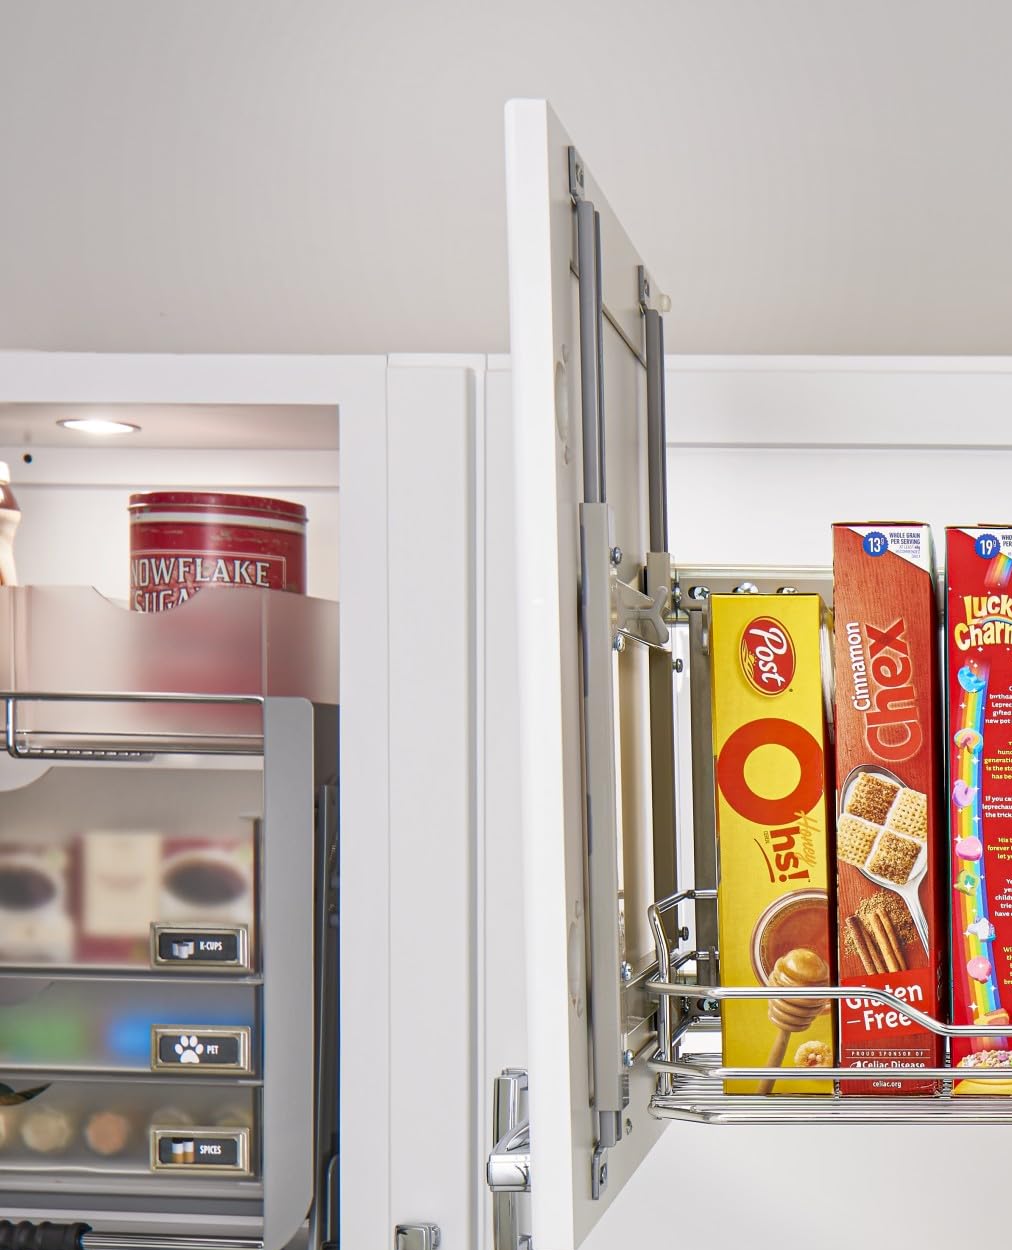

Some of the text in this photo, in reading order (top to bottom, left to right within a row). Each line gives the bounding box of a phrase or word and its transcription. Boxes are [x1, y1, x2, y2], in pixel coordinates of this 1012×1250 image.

[134, 588, 201, 613] SUGA
[749, 627, 789, 687] Post
[845, 621, 871, 711] Cinnamon
[864, 617, 924, 762] Chex
[199, 941, 223, 951] K-CUPS
[863, 1009, 912, 1031] Free
[206, 1045, 219, 1055] PET
[872, 1080, 902, 1088] celiac.org
[199, 1145, 222, 1155] SPICES
